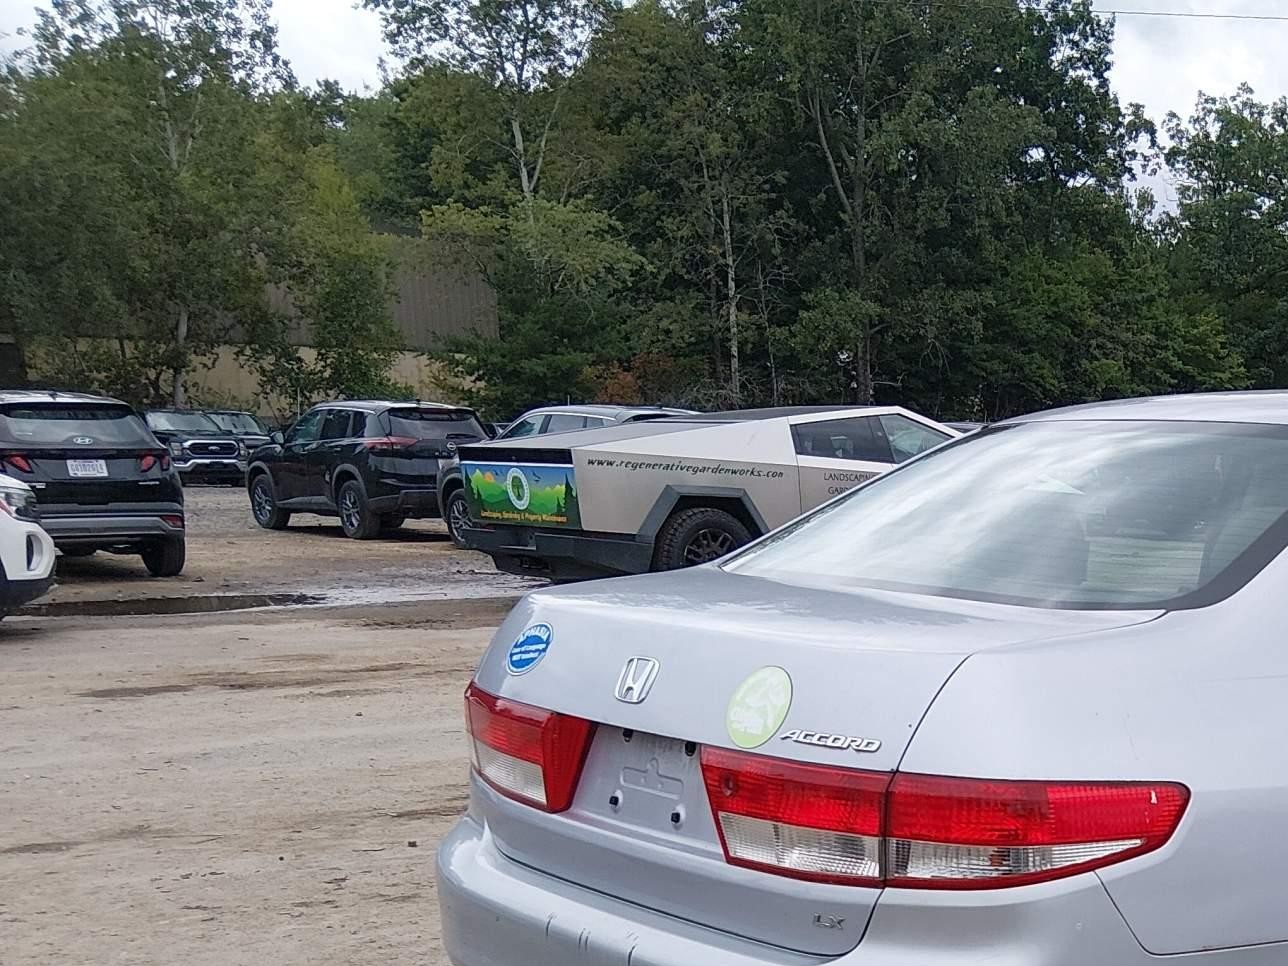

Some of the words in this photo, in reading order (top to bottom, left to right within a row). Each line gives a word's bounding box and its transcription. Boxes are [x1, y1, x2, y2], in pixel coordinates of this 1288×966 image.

[828, 486, 852, 495] GARD
[779, 729, 882, 753] ACCORD
[812, 912, 846, 930] LX
